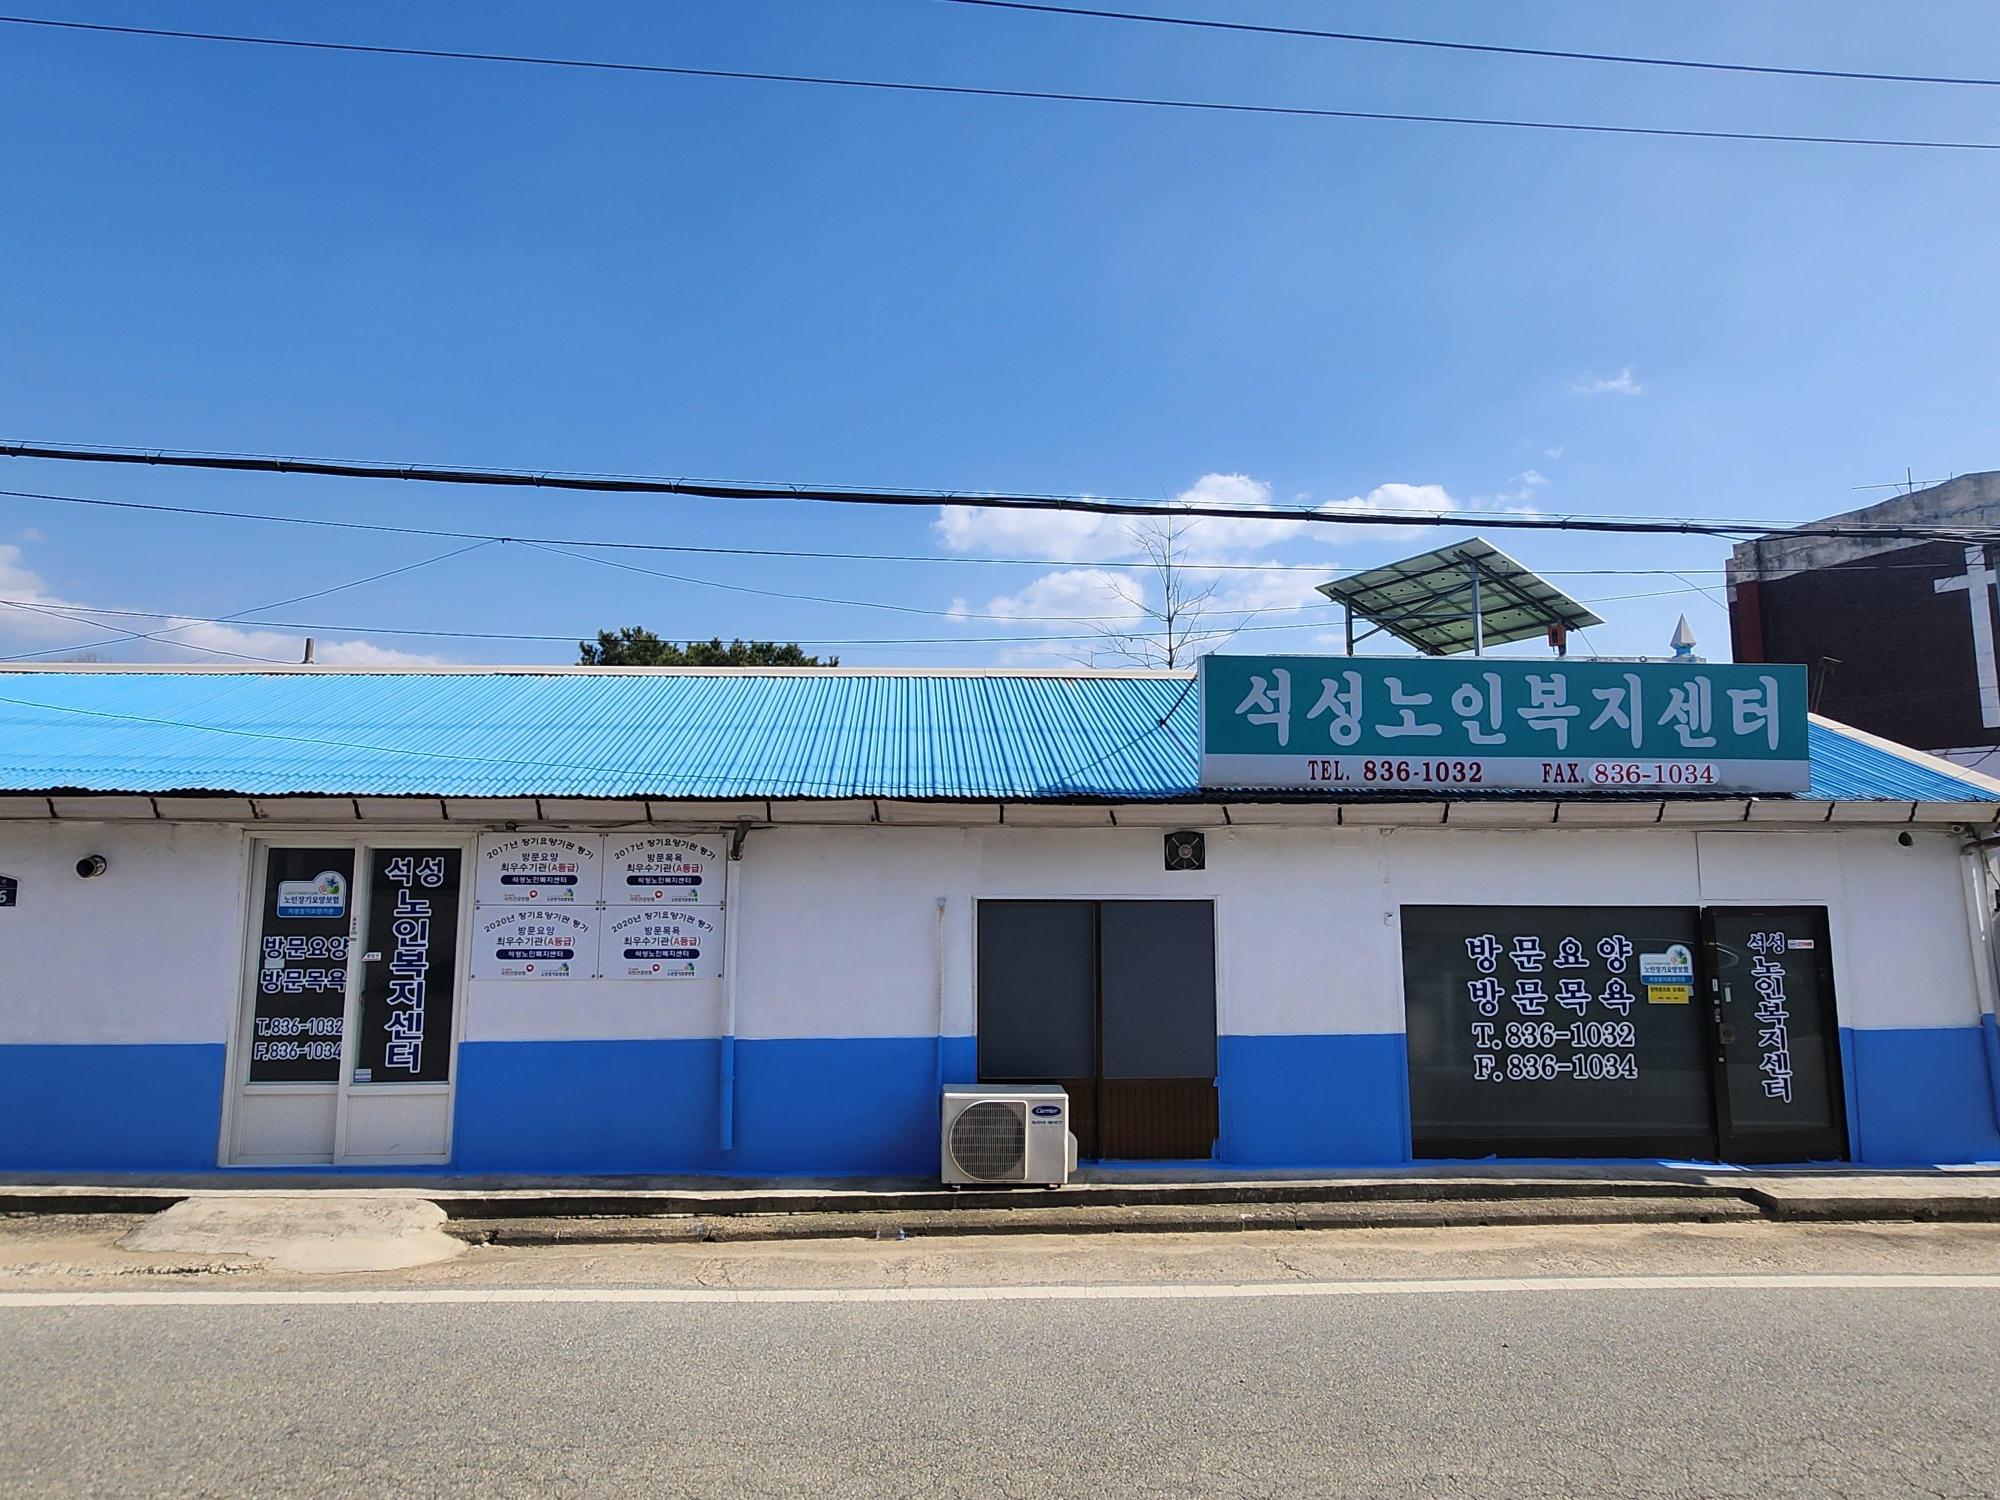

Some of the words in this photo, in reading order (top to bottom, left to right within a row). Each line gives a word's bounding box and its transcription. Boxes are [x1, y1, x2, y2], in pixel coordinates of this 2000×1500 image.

[1234, 668, 1780, 750] 석성노인복지센터
[1307, 761, 1351, 783] TEL.
[1362, 761, 1483, 784] 836-1032
[1541, 763, 1585, 784] FAX.
[1593, 763, 1714, 784] 836-1034
[521, 852, 558, 862] 방문요양
[647, 853, 683, 862] 방문목욕
[517, 926, 555, 936] 방문요양
[644, 926, 680, 936] 방문목욕
[263, 936, 349, 960] 방문요양
[261, 968, 347, 993] 방문목욕
[256, 1017, 344, 1036] T.836-1032
